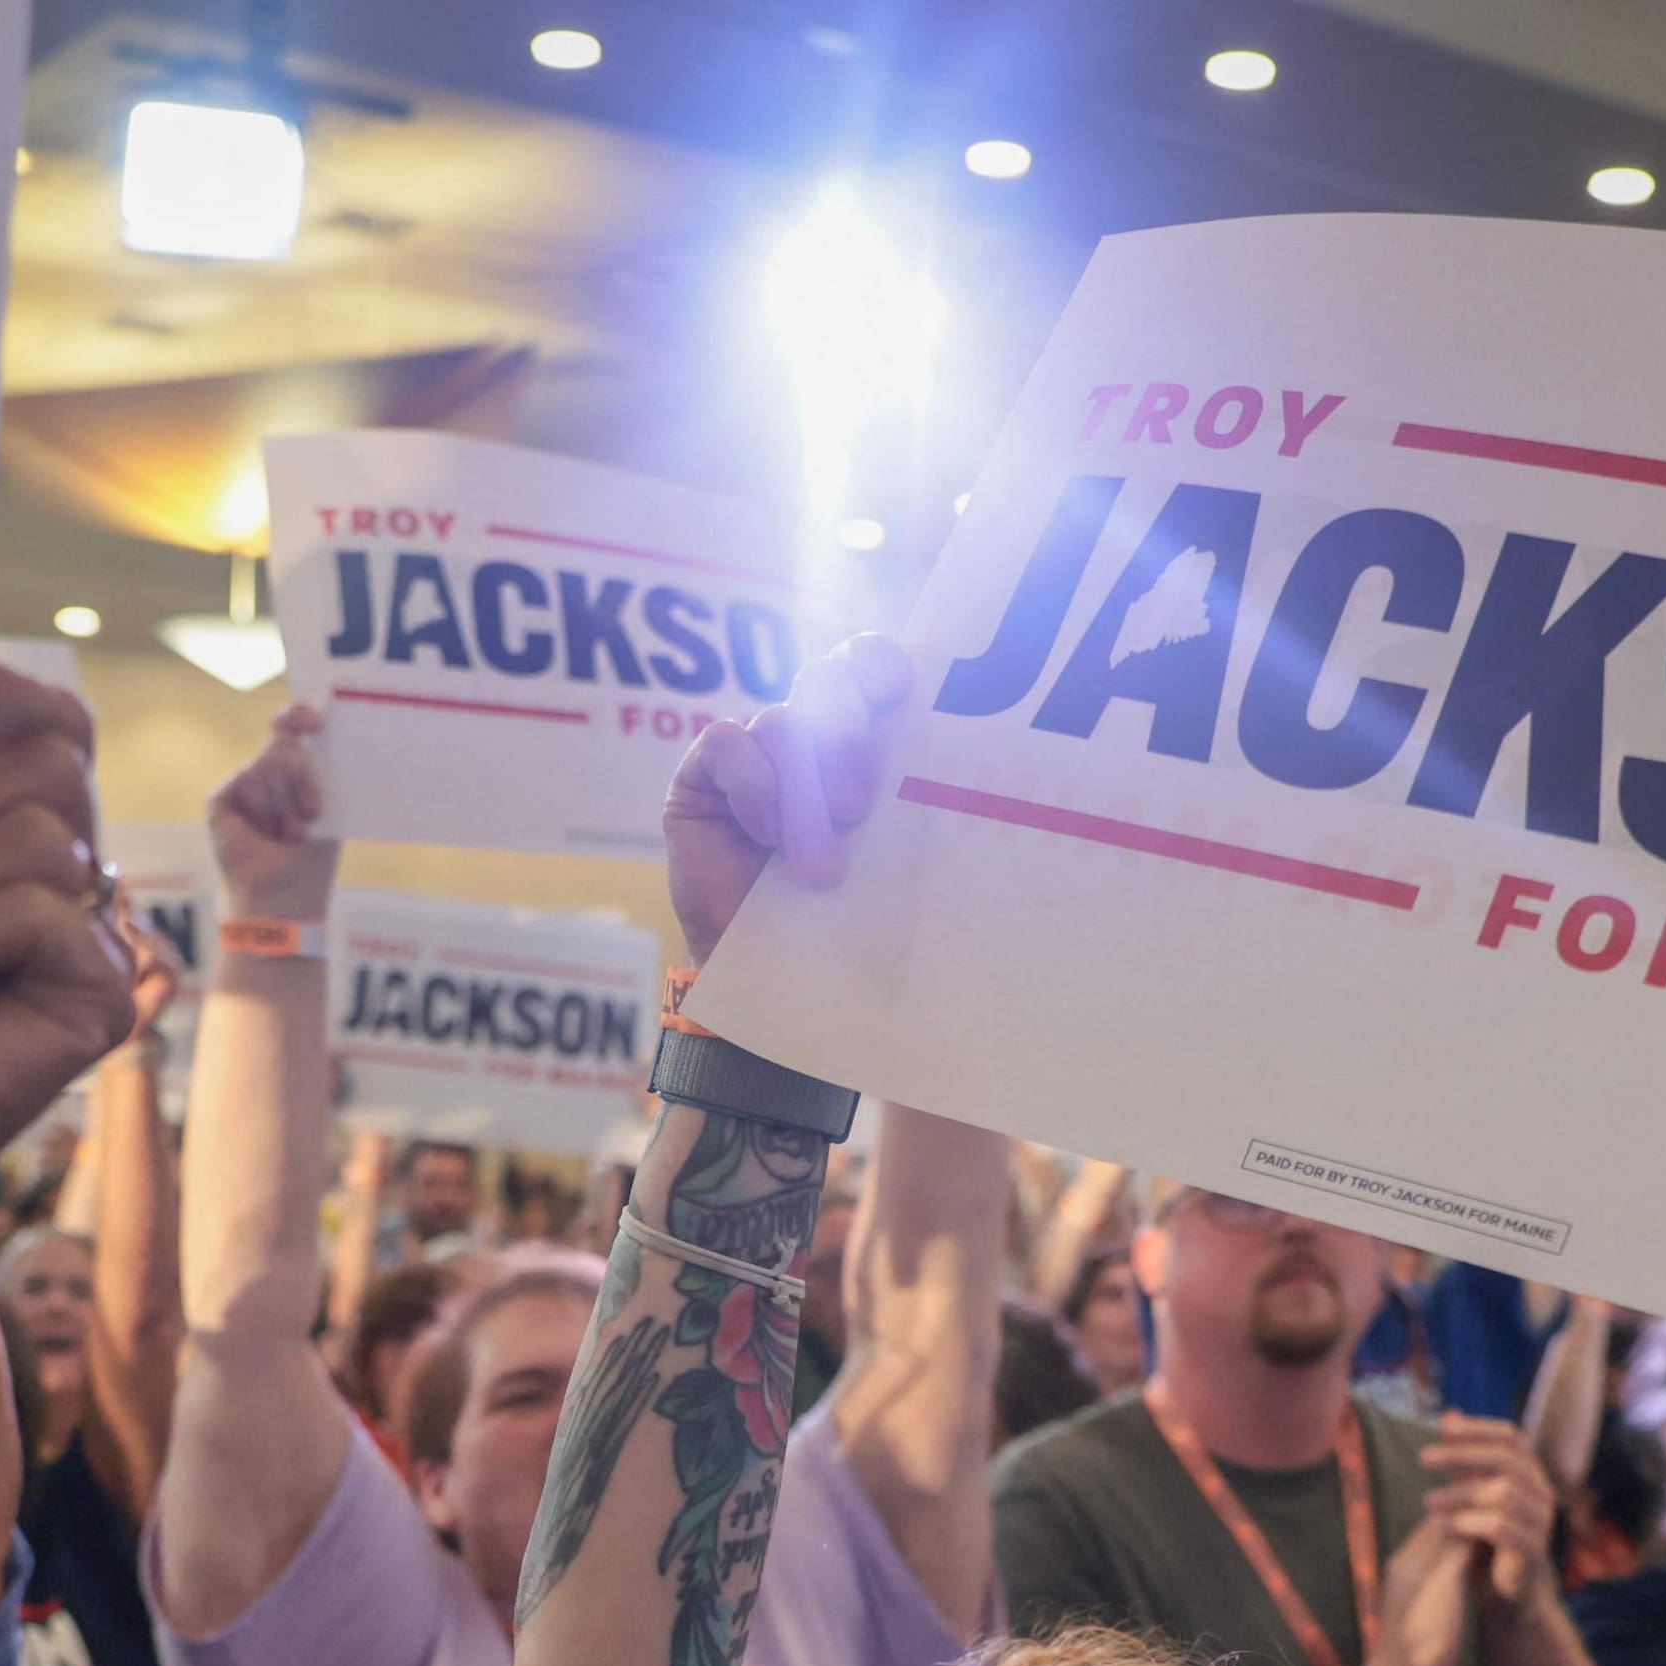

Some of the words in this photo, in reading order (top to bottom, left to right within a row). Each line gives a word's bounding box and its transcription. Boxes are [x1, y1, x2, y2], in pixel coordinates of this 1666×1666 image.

[1081, 381, 1345, 459] TROY
[315, 506, 457, 539] TROY
[326, 548, 797, 704] JACKSO
[343, 961, 639, 1063] JACKSON
[1255, 1151, 1291, 1171] PAID
[1293, 1161, 1325, 1180] FOR
[1327, 1171, 1349, 1187] BY
[1351, 1176, 1391, 1197] TROY
[1391, 1188, 1465, 1217] JACKSON
[1468, 1209, 1501, 1227] FOR
[1504, 1219, 1556, 1243] MAINE
